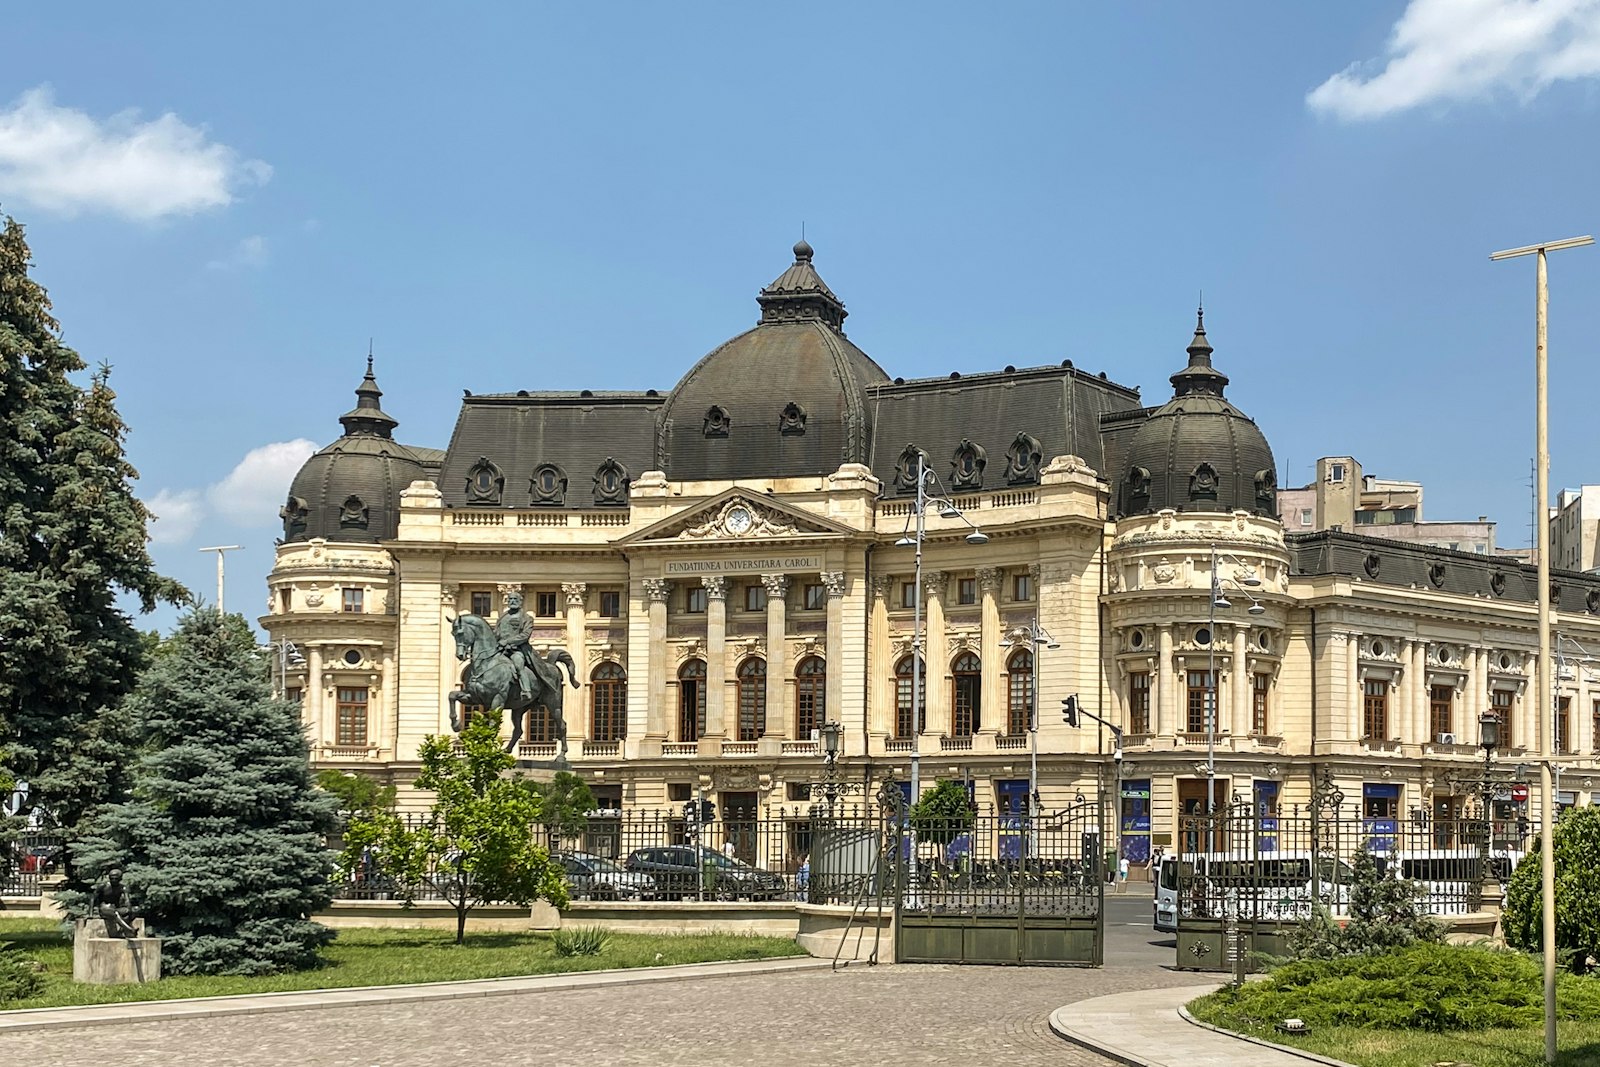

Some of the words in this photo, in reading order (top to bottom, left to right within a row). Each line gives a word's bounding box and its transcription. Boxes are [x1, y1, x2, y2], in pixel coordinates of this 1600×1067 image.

[669, 562, 721, 571] FUNDATIUNEA
[724, 559, 781, 570] UNIVERSITARA
[784, 558, 812, 567] CAROL
